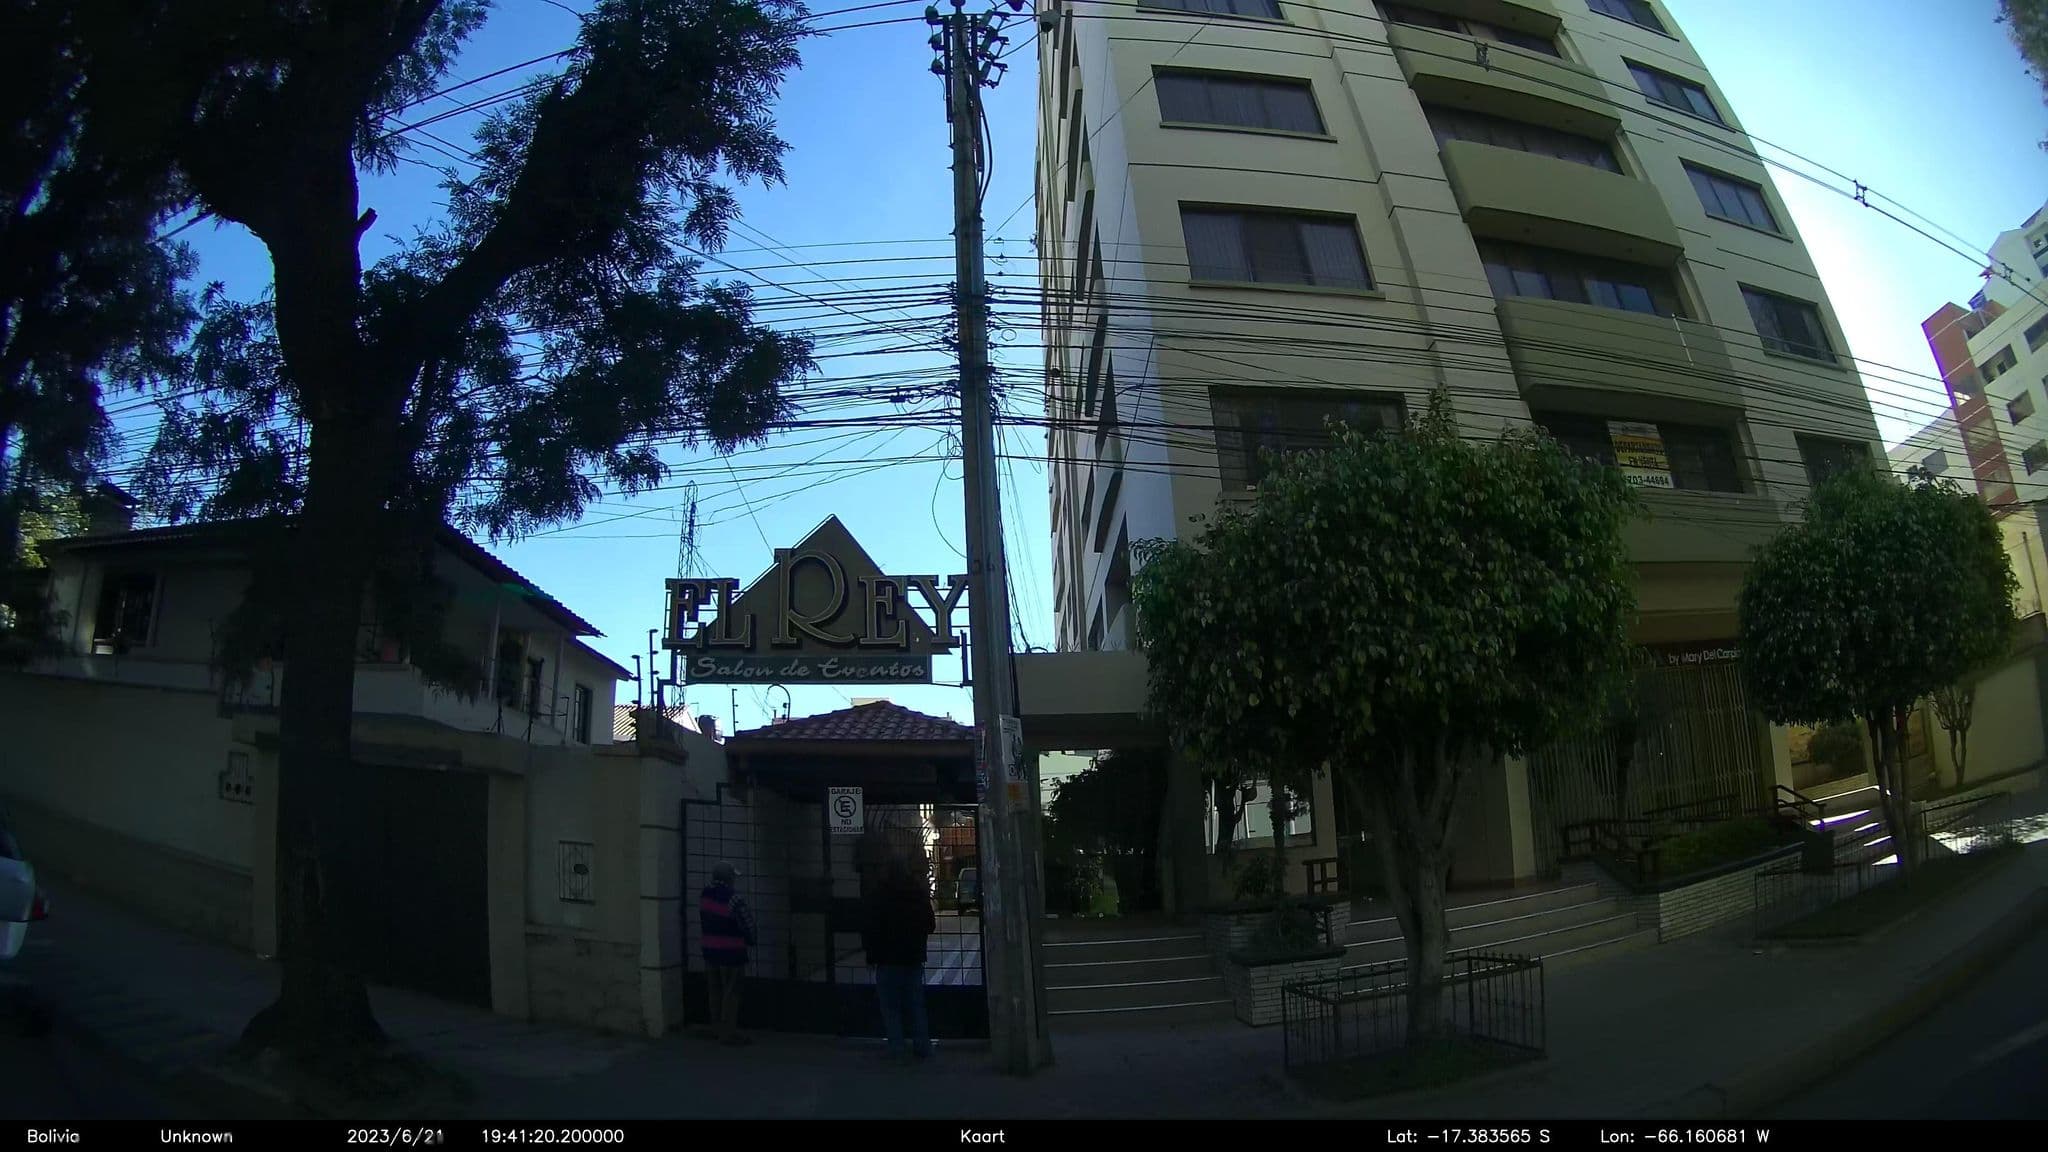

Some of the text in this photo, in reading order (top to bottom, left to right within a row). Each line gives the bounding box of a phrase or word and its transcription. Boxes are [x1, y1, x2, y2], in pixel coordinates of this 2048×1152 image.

[662, 548, 968, 649] EL REY
[1668, 653, 1680, 666] by
[1681, 651, 1703, 665] Mary
[1703, 648, 1717, 661] Del
[690, 656, 924, 679] Salon de Eventos
[840, 818, 852, 826] NO
